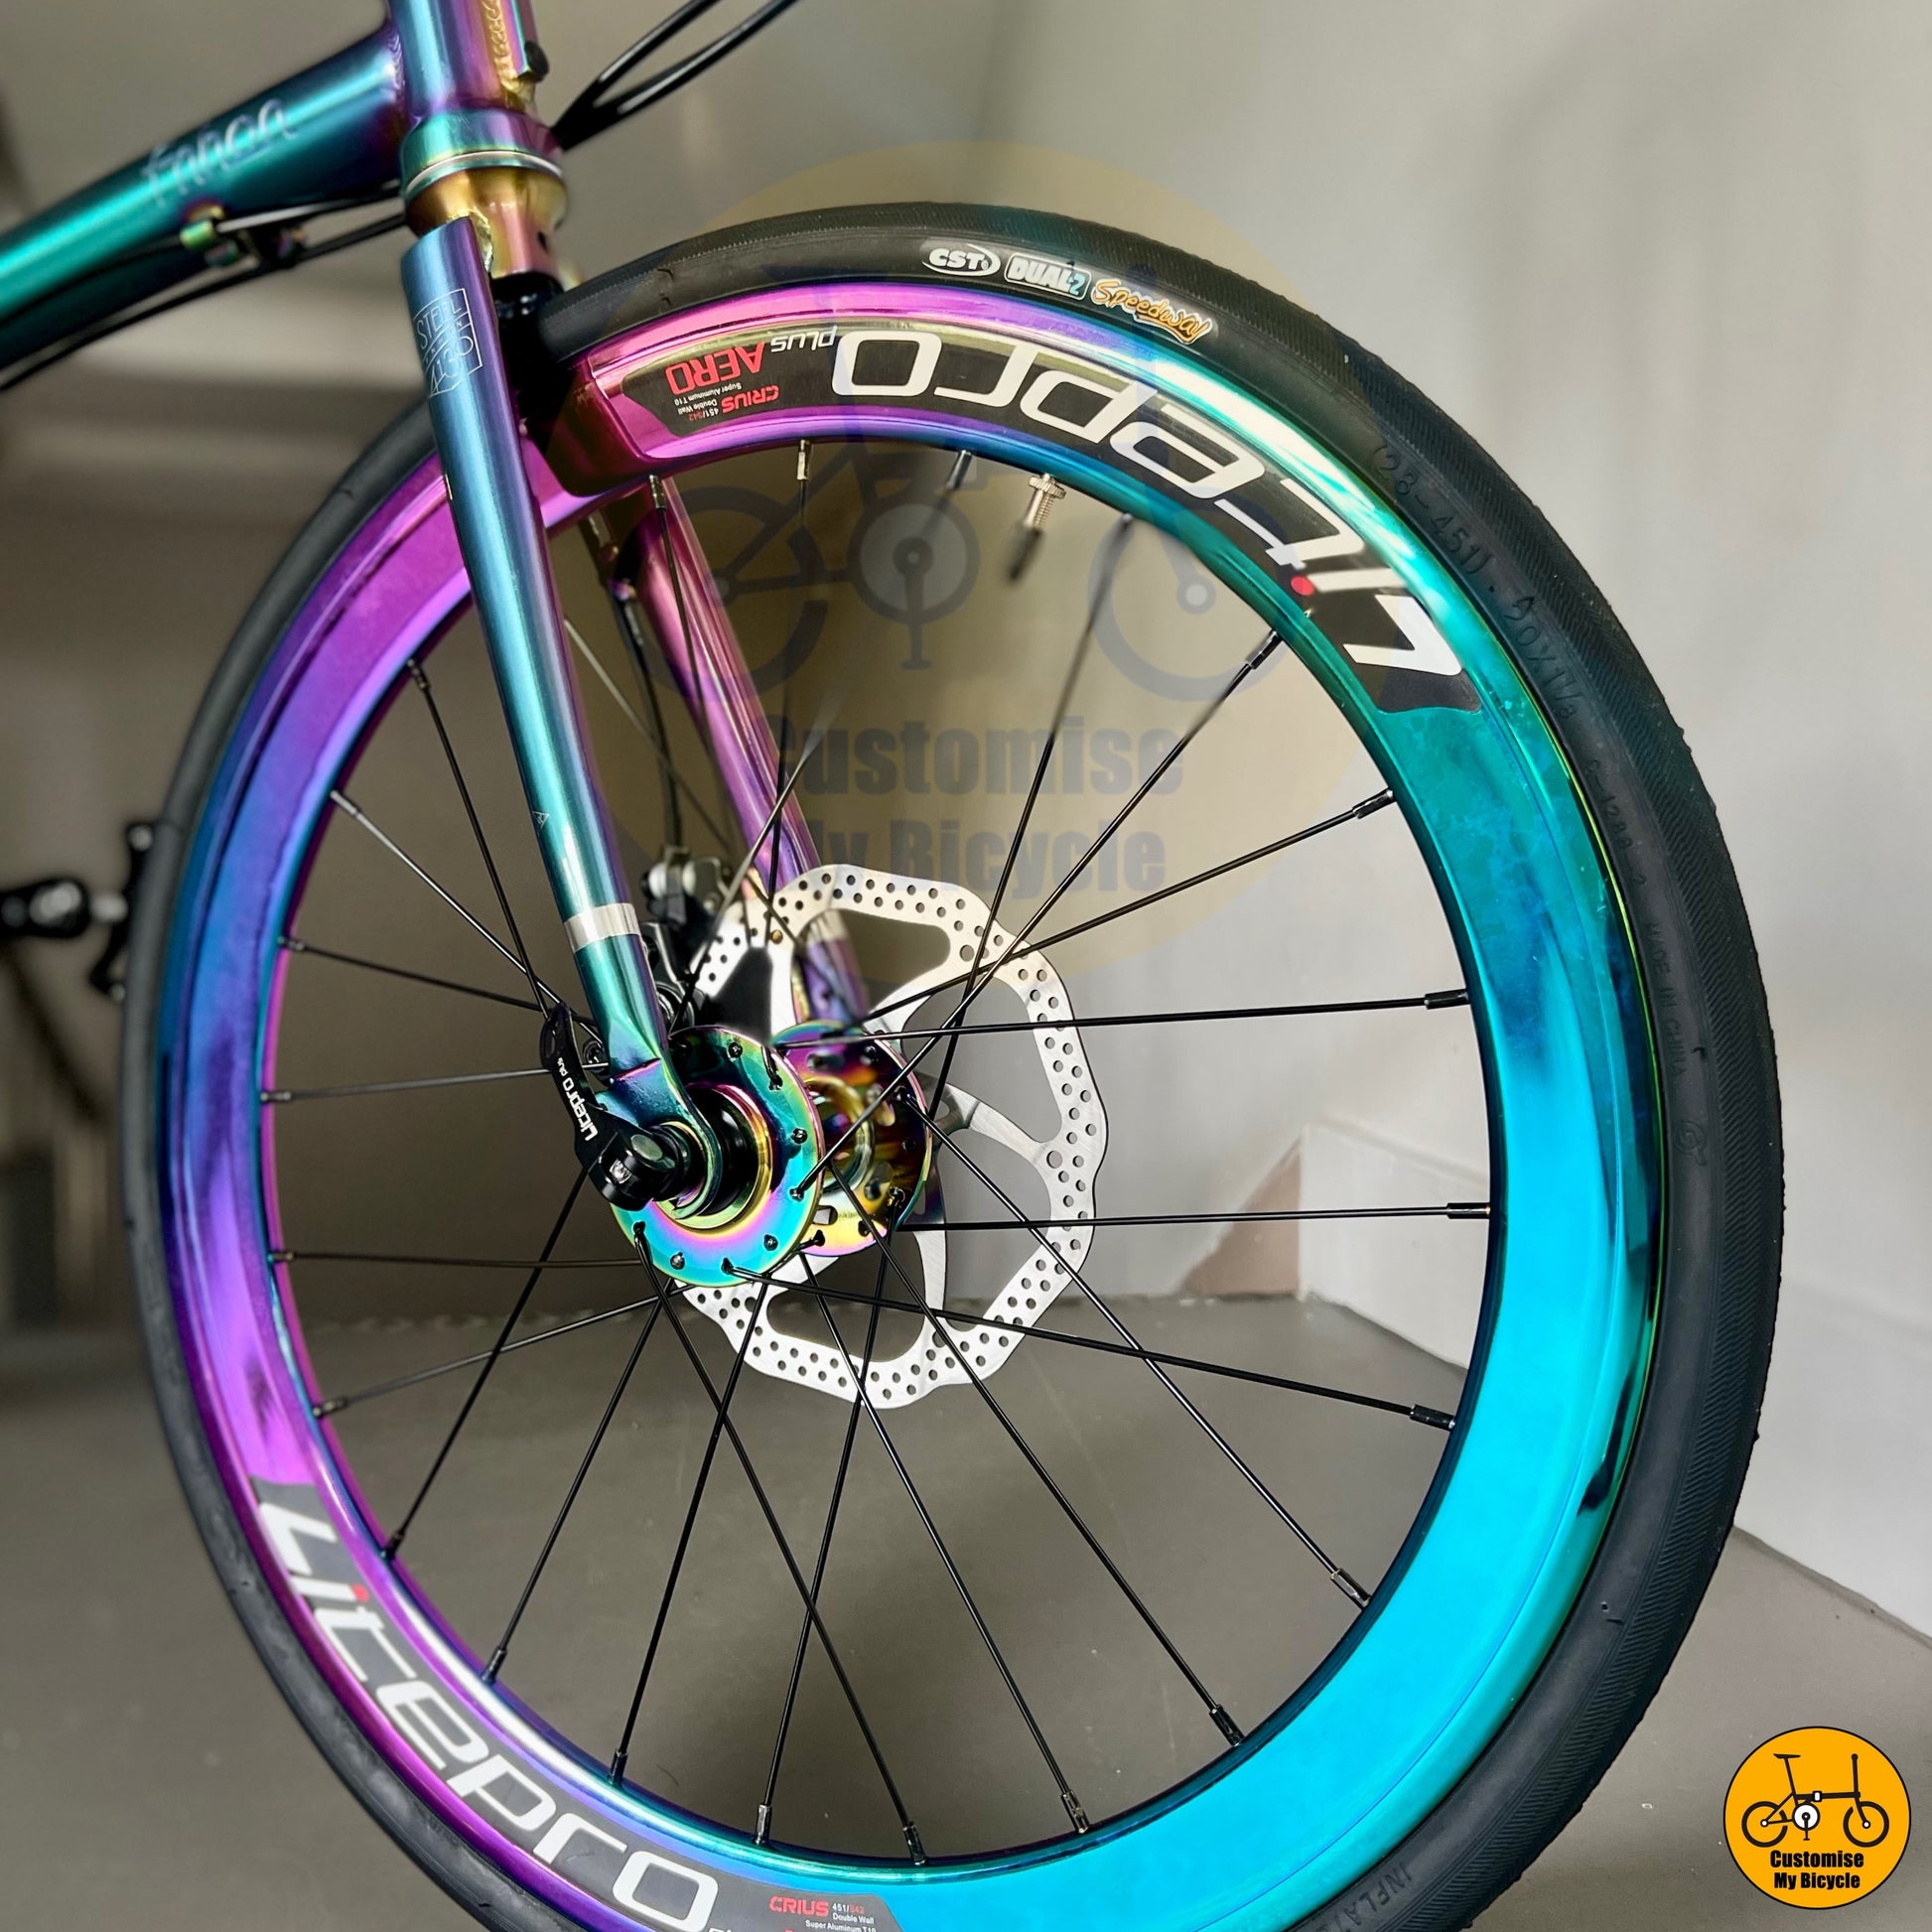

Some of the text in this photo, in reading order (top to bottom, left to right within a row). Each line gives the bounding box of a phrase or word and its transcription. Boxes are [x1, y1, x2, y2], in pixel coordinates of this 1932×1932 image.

[929, 248, 987, 271] CST
[1092, 280, 1211, 344] Speedway
[417, 299, 463, 350] STEEL
[430, 336, 475, 392] 4130
[665, 342, 764, 395] AERO
[687, 388, 721, 401] Aluminum
[721, 382, 743, 393] Super
[721, 385, 779, 413] CRIUS
[693, 399, 717, 410] Double
[1646, 921, 1688, 1077] MADE IN CHINA
[769, 1895, 829, 1917] CRIUS
[833, 1912, 858, 1923] Double
[805, 1919, 826, 1929] Super
[827, 1922, 862, 1932] Aluminum
